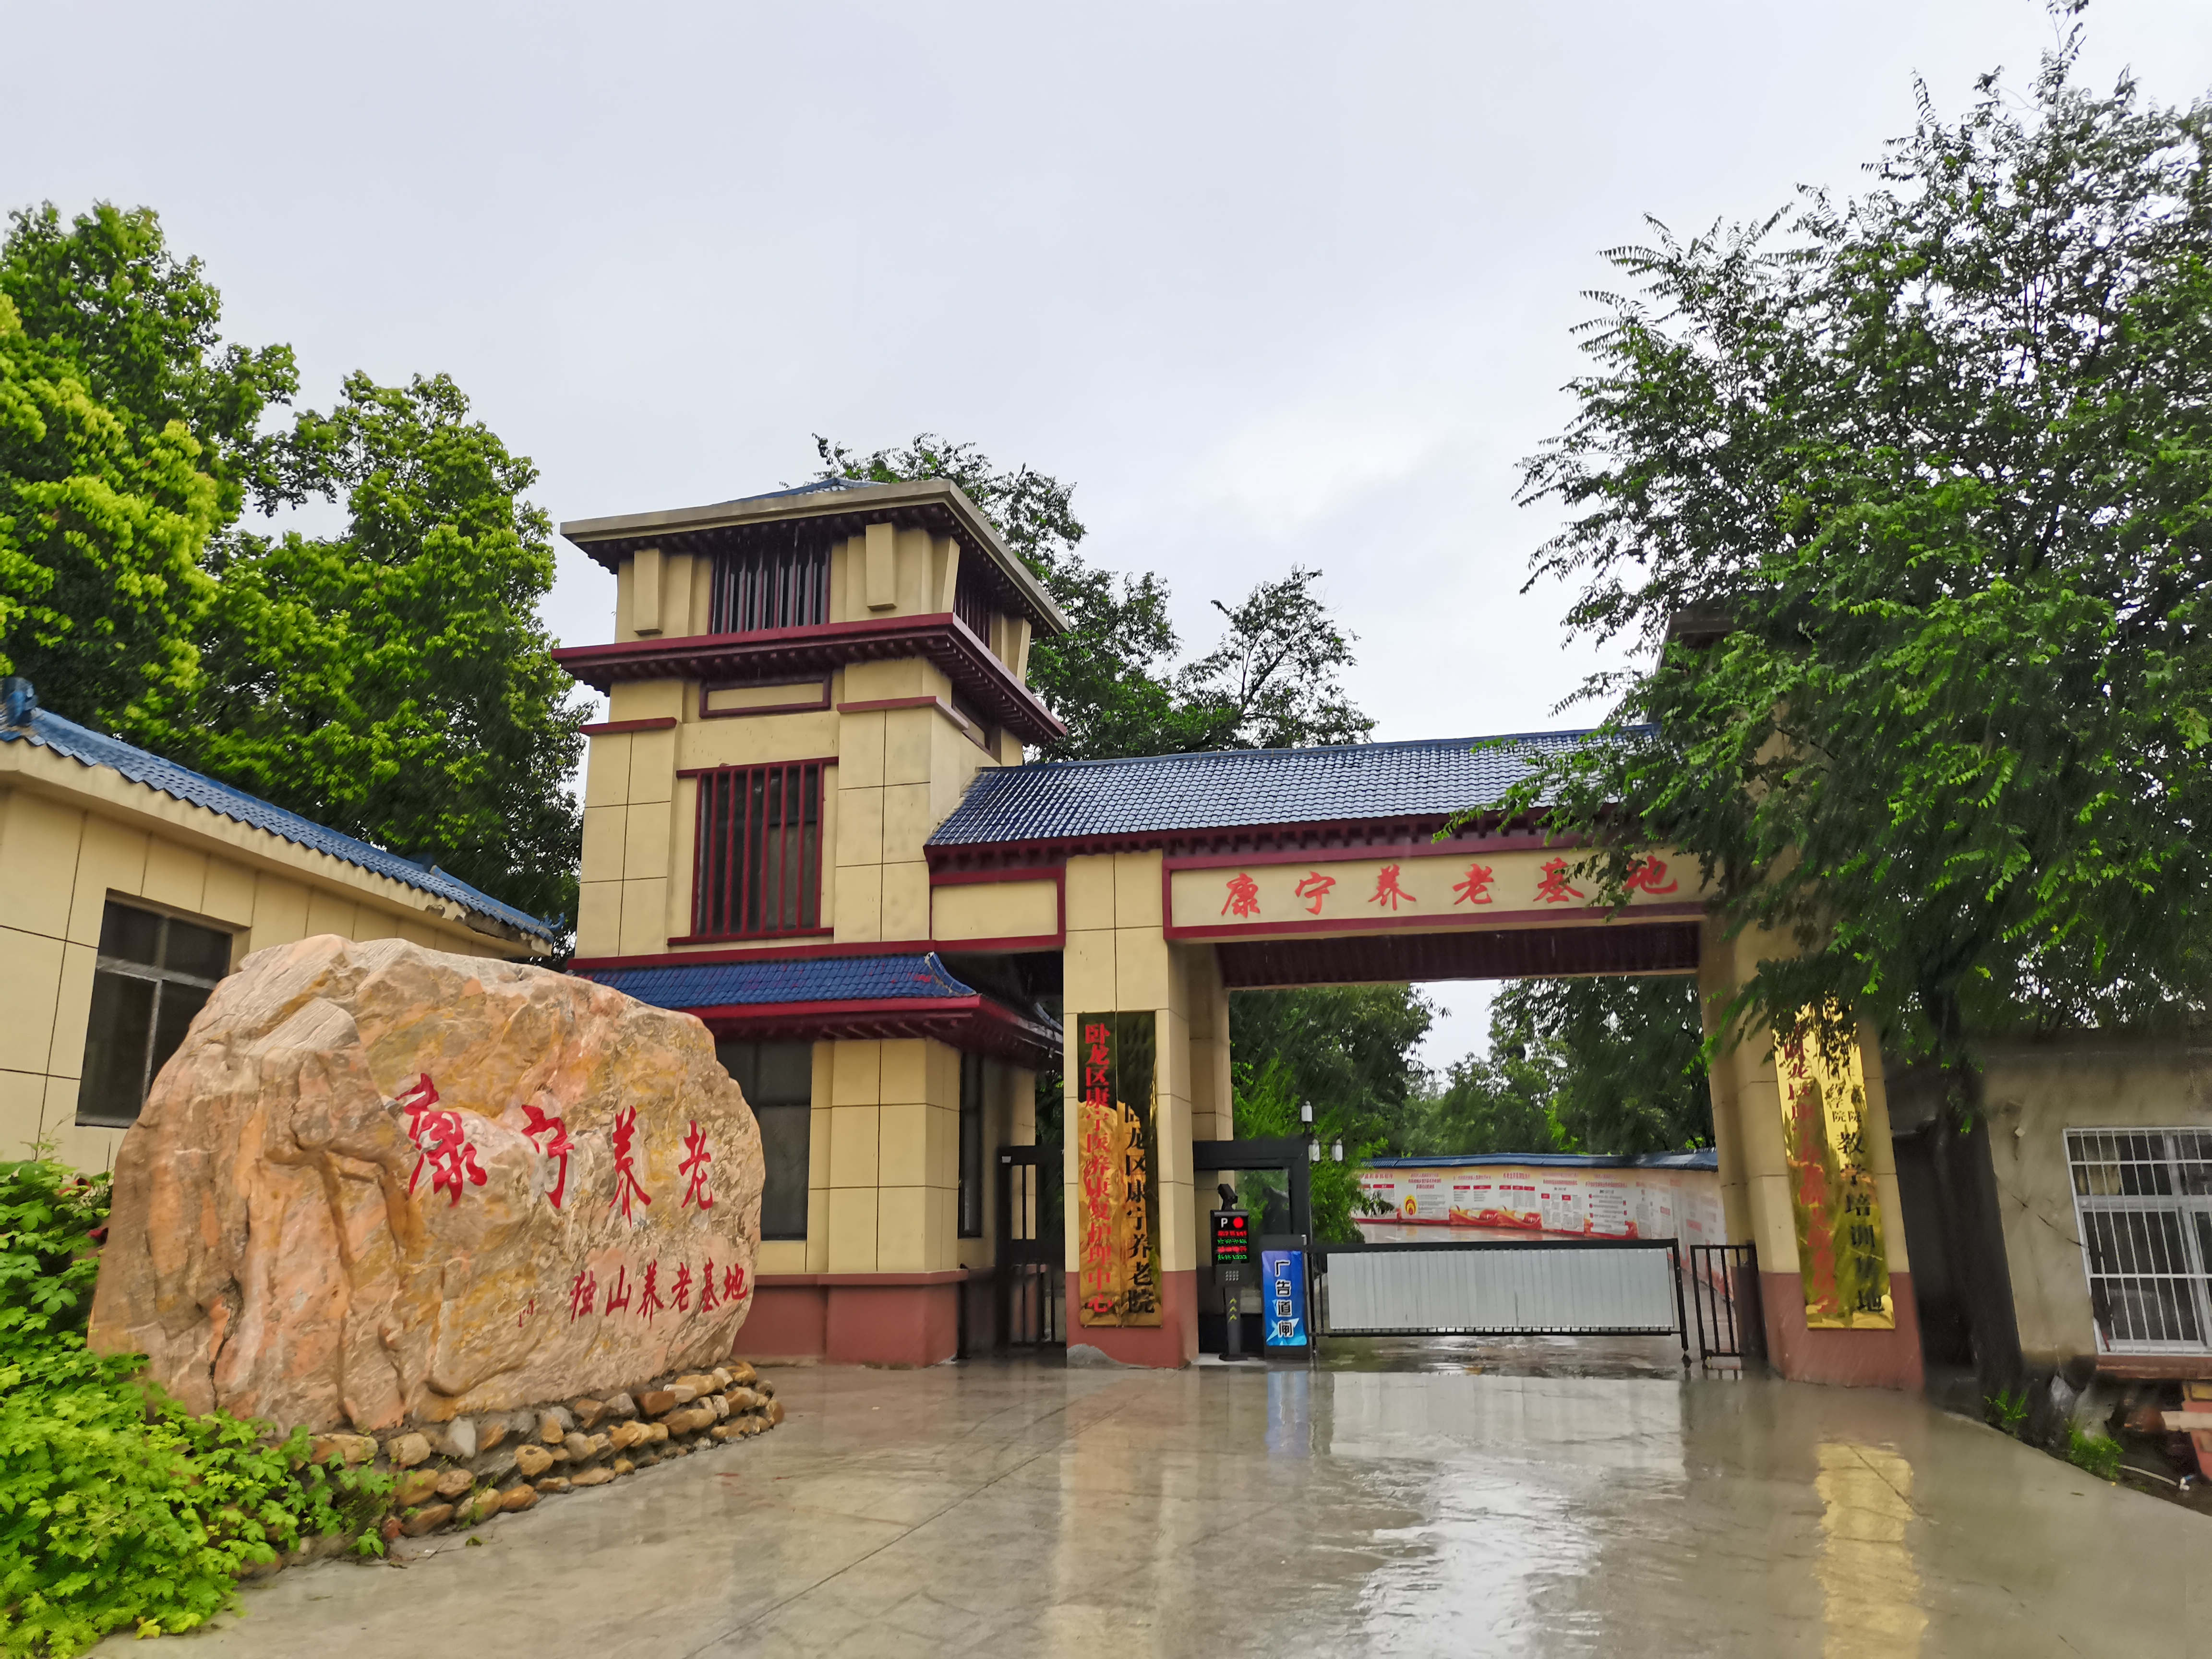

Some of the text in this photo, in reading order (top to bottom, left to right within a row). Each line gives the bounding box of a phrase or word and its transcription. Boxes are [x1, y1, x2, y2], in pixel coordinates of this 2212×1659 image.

[1221, 855, 1678, 919] 康宁养老基地
[1221, 1217, 1228, 1228] P
[570, 1257, 747, 1329] 独山养老基地
[1274, 1260, 1294, 1338] 广告道闸
